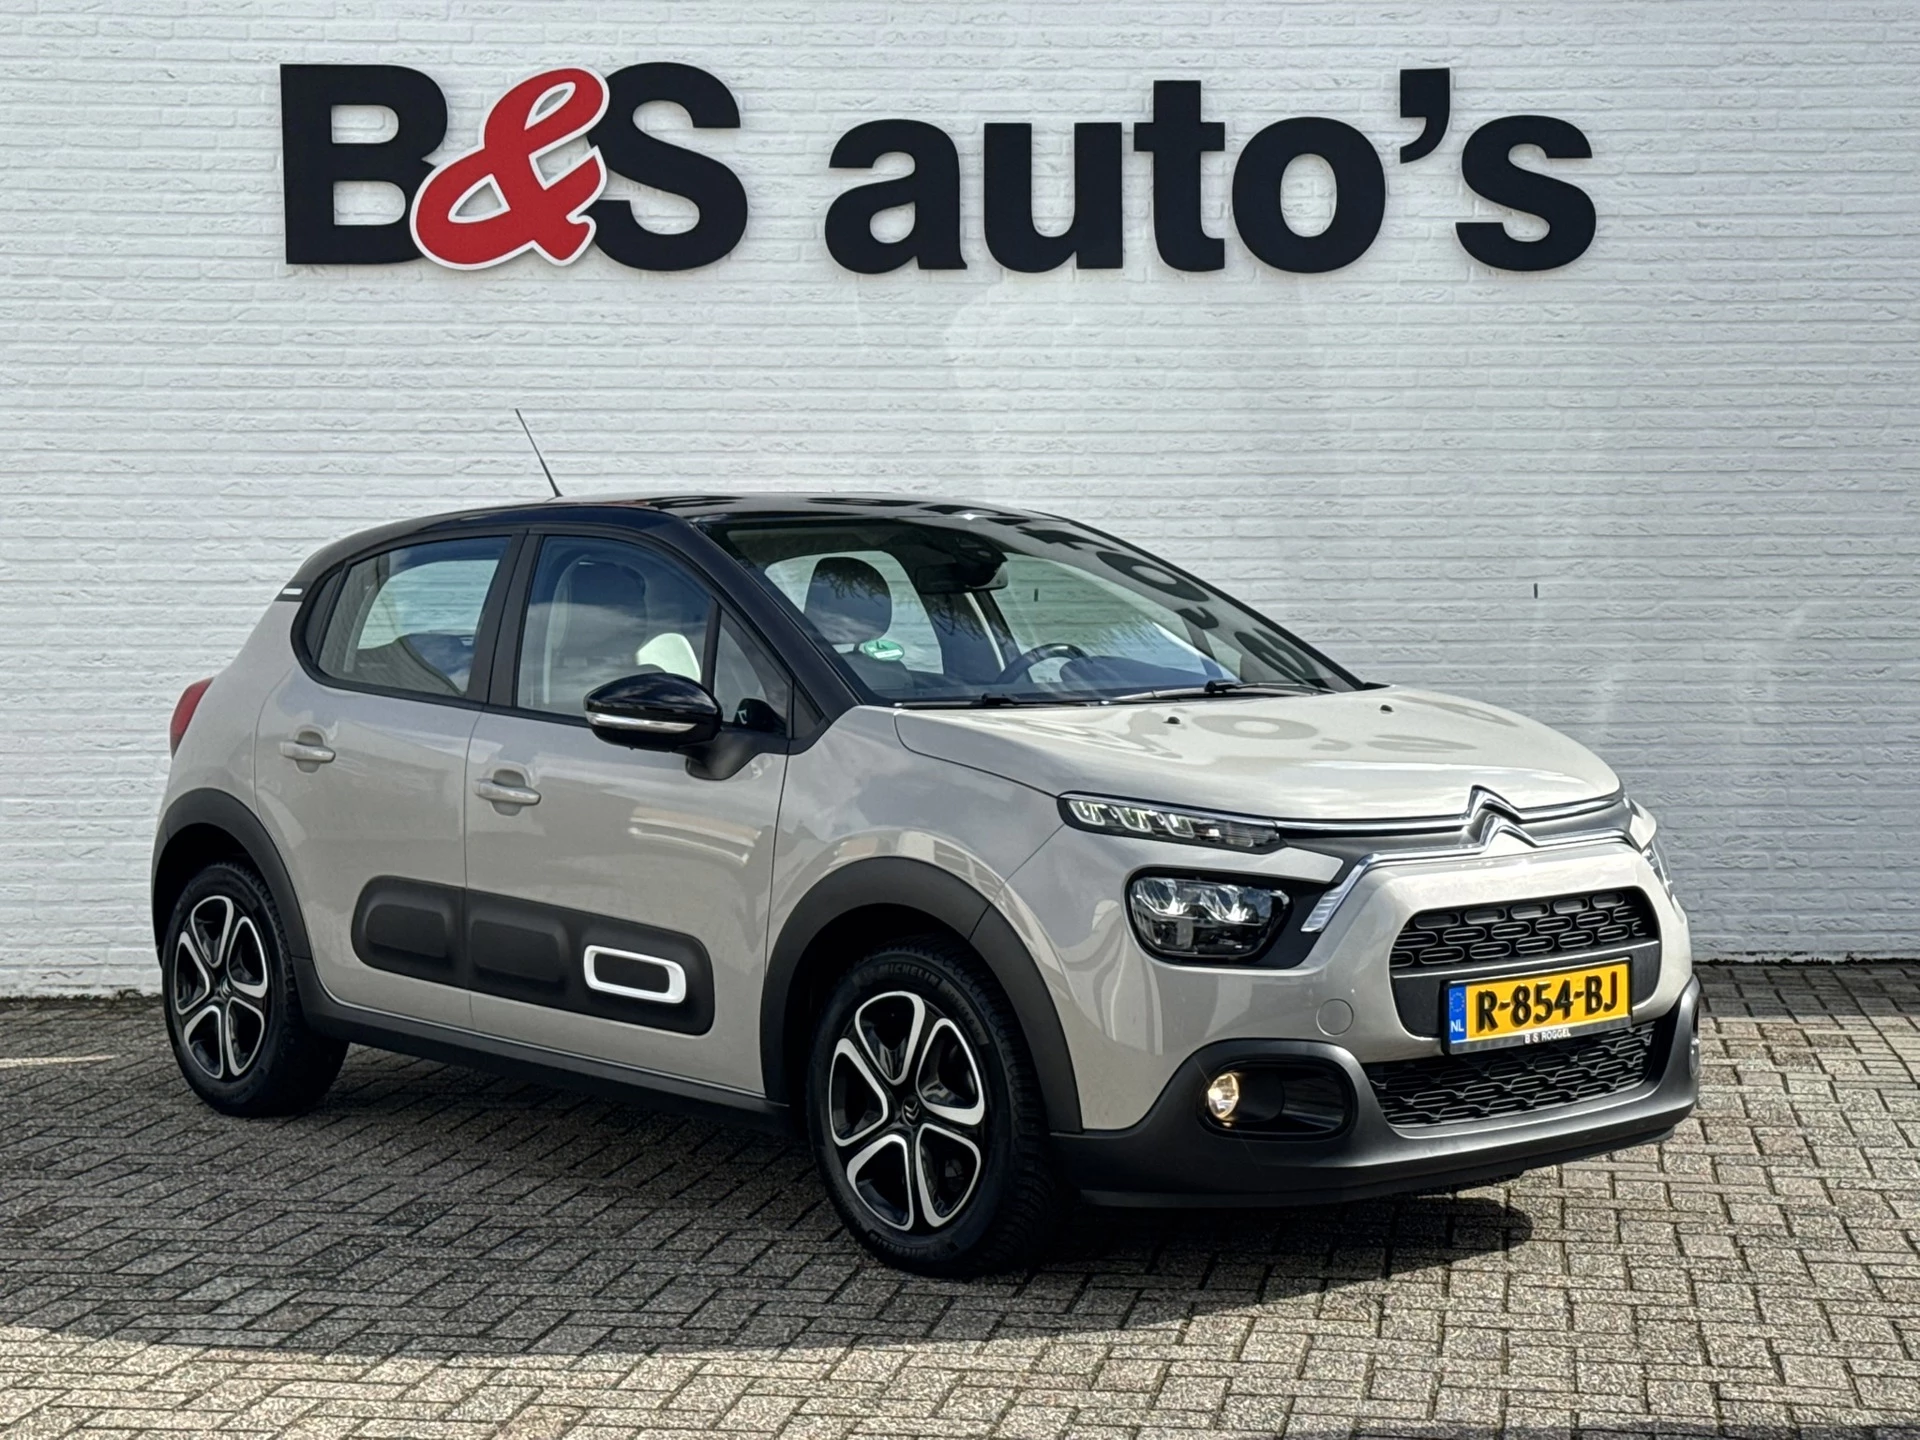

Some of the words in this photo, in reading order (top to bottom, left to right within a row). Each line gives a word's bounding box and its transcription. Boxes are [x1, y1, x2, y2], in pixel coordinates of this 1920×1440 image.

[280, 62, 748, 272] B&S
[824, 69, 1597, 275] auto's
[878, 963, 941, 987] MICHELIN
[1475, 970, 1618, 1034] R-854-BJ
[1450, 1019, 1465, 1033] NL
[1541, 1028, 1572, 1042] ROGGEL
